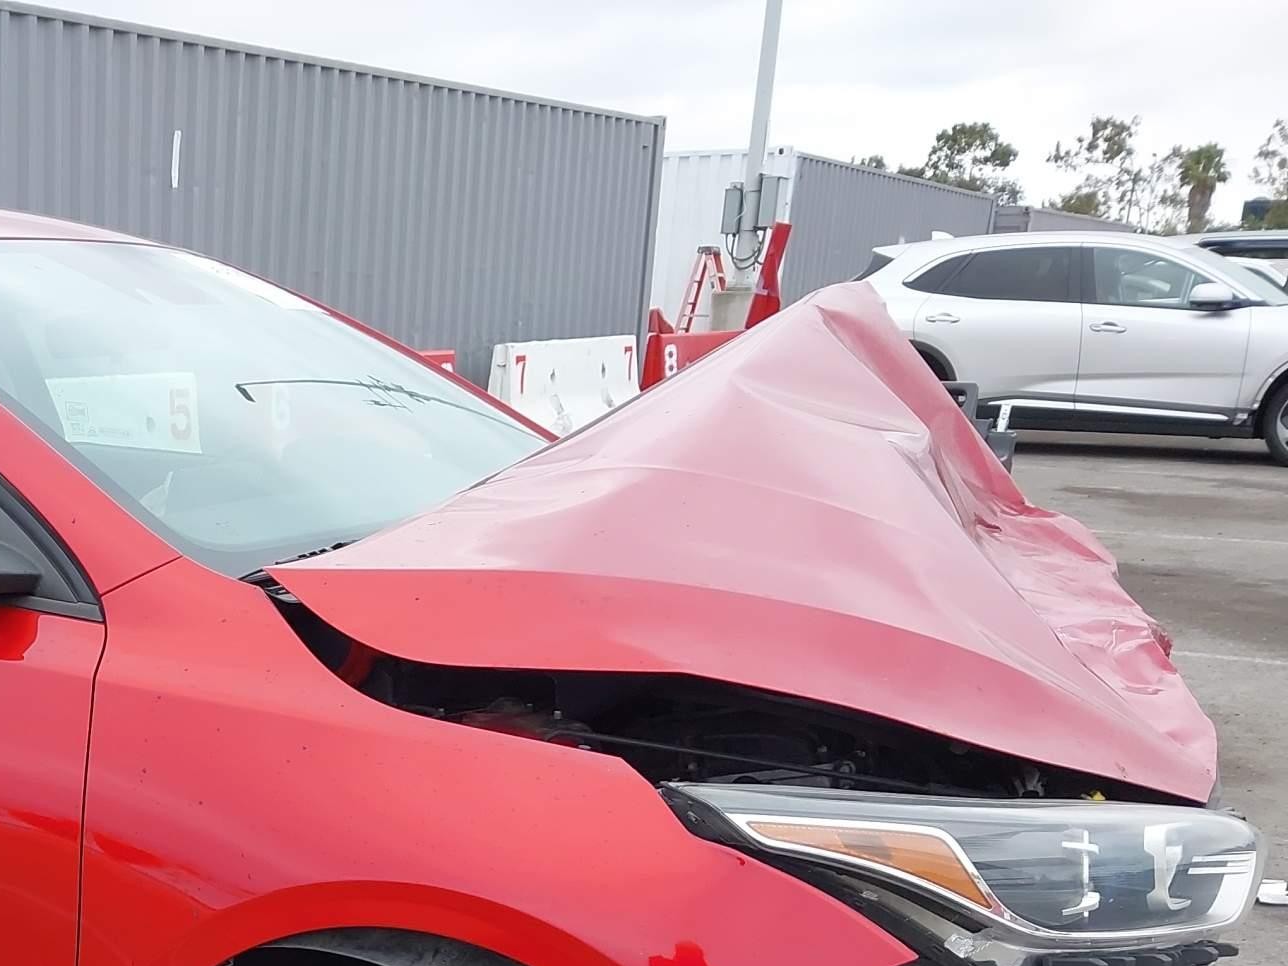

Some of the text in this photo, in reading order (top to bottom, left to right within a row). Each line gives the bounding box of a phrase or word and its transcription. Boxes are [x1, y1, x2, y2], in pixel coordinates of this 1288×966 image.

[515, 345, 634, 395] 7 7
[664, 343, 678, 378] 8
[169, 387, 192, 441] 5
